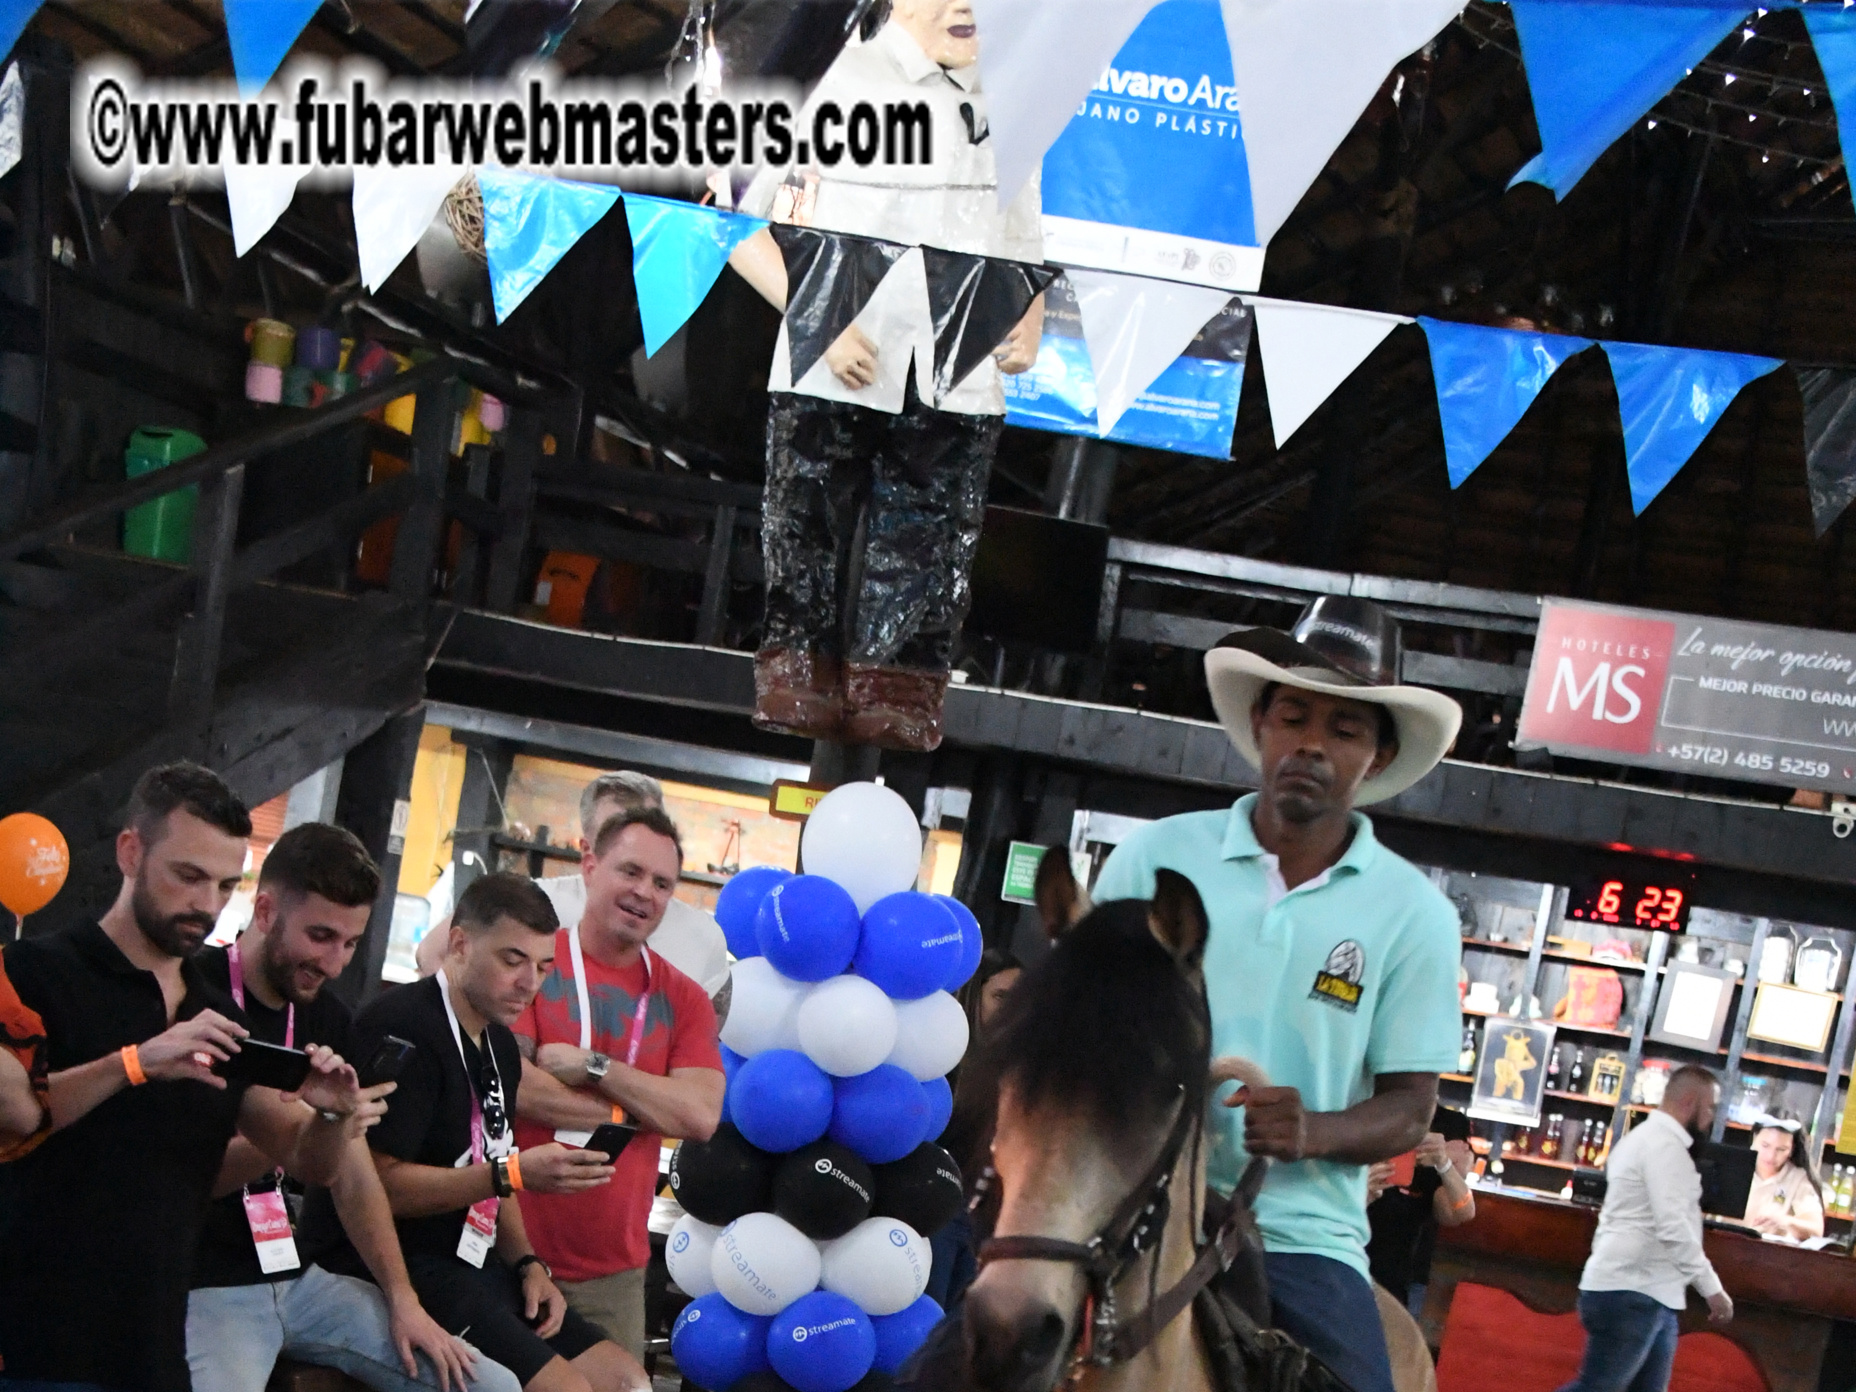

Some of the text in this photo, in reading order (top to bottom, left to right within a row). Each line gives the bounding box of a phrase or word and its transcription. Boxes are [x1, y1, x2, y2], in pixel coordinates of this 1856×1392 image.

[1561, 636, 1651, 660] HOTELES
[1677, 627, 1706, 657] La
[1711, 641, 1776, 671] mejor
[1546, 655, 1646, 725] MS
[1699, 675, 1749, 694] MEJOR
[1752, 681, 1807, 702] PRECIO
[1668, 742, 1831, 779] +57(2) 485 5259
[1597, 880, 1684, 922] 6 23
[830, 1167, 871, 1203] streamate
[722, 1232, 778, 1301] streamate
[807, 1316, 856, 1337] streamate
